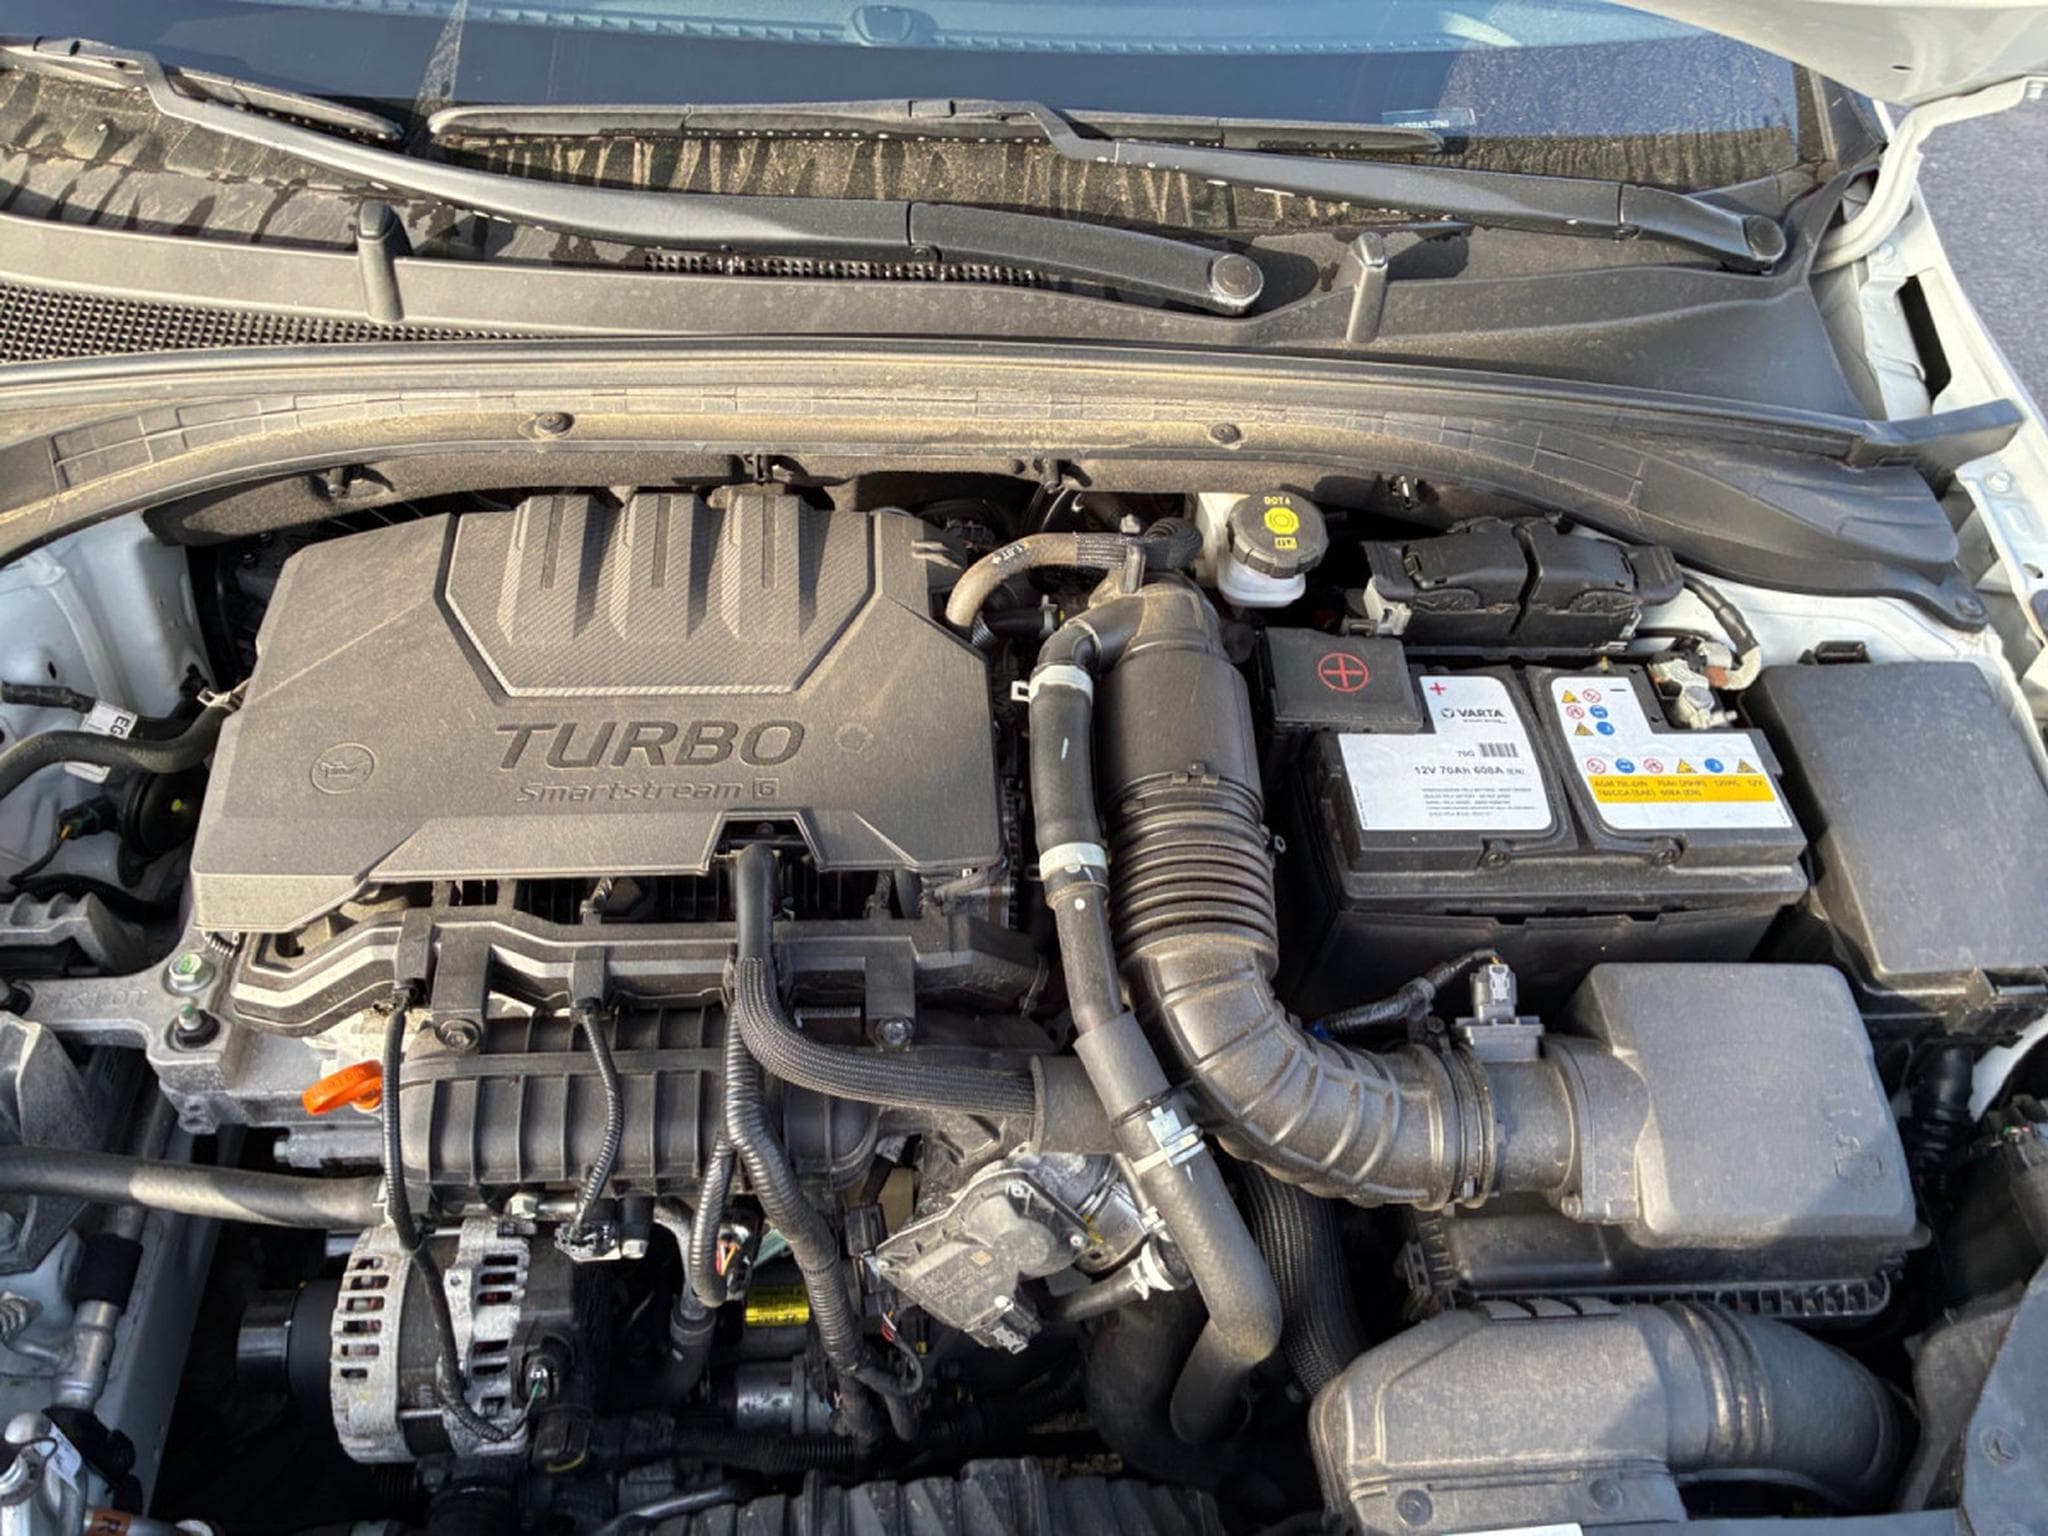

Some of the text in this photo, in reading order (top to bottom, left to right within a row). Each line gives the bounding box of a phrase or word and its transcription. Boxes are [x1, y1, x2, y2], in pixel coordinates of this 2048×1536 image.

[1456, 708, 1505, 718] VARTA
[496, 719, 806, 769] TURBO
[1415, 766, 1437, 775] 12V
[1440, 766, 1471, 775] 70Ah
[515, 778, 744, 802] Smartstream
